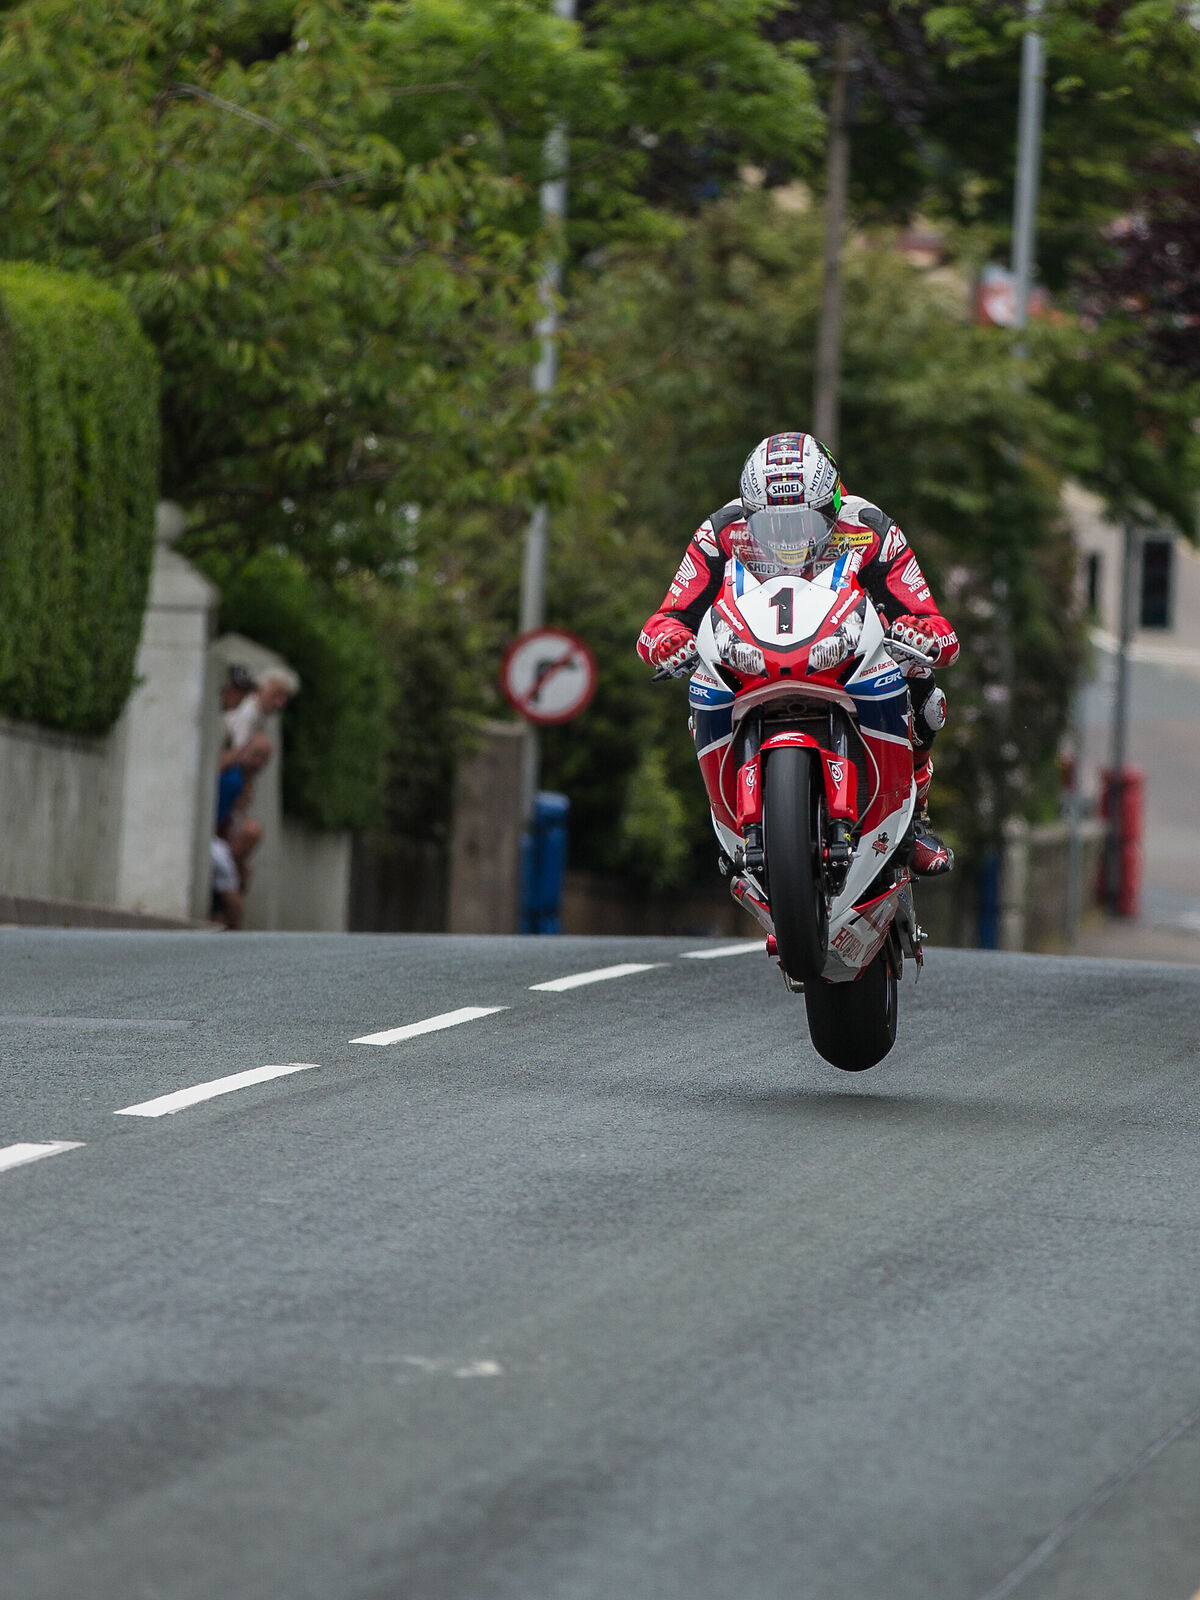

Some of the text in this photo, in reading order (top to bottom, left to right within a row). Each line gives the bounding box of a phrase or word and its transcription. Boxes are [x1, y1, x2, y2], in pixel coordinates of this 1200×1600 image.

[772, 484, 799, 495] SHOEI
[749, 561, 776, 574] SHOEI
[674, 573, 690, 588] NDA
[908, 579, 926, 593] HON
[669, 582, 683, 597] TUL
[769, 587, 794, 635] 1
[860, 660, 895, 677] Honda Racing
[874, 672, 902, 688] CBR
[690, 686, 711, 699] CBR
